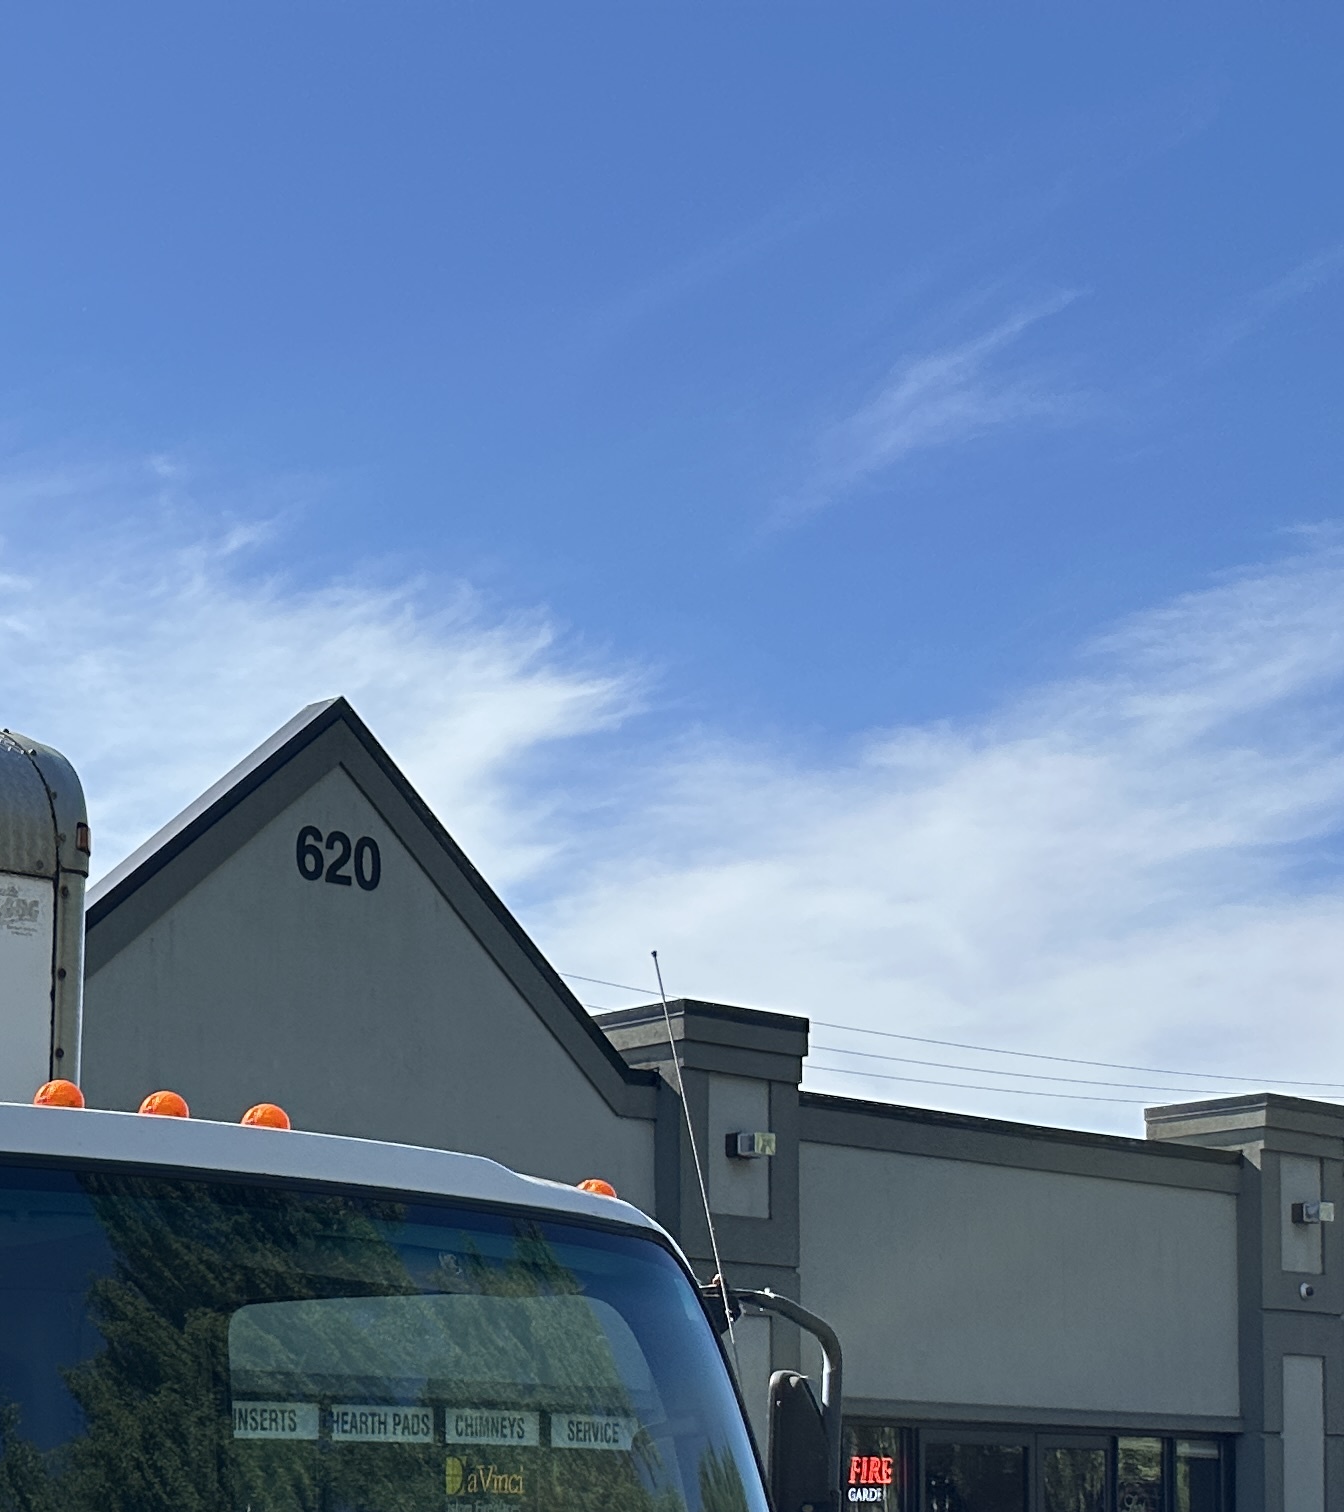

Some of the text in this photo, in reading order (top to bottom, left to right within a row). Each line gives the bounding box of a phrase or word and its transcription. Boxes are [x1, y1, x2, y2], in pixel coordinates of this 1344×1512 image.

[296, 825, 381, 891] 620
[233, 1408, 297, 1432] INSERTS
[330, 1410, 430, 1437] HEARTH PADS
[455, 1414, 525, 1440] CHIMNEYS
[567, 1420, 620, 1444] SERVICE
[848, 1456, 893, 1484] FIRE
